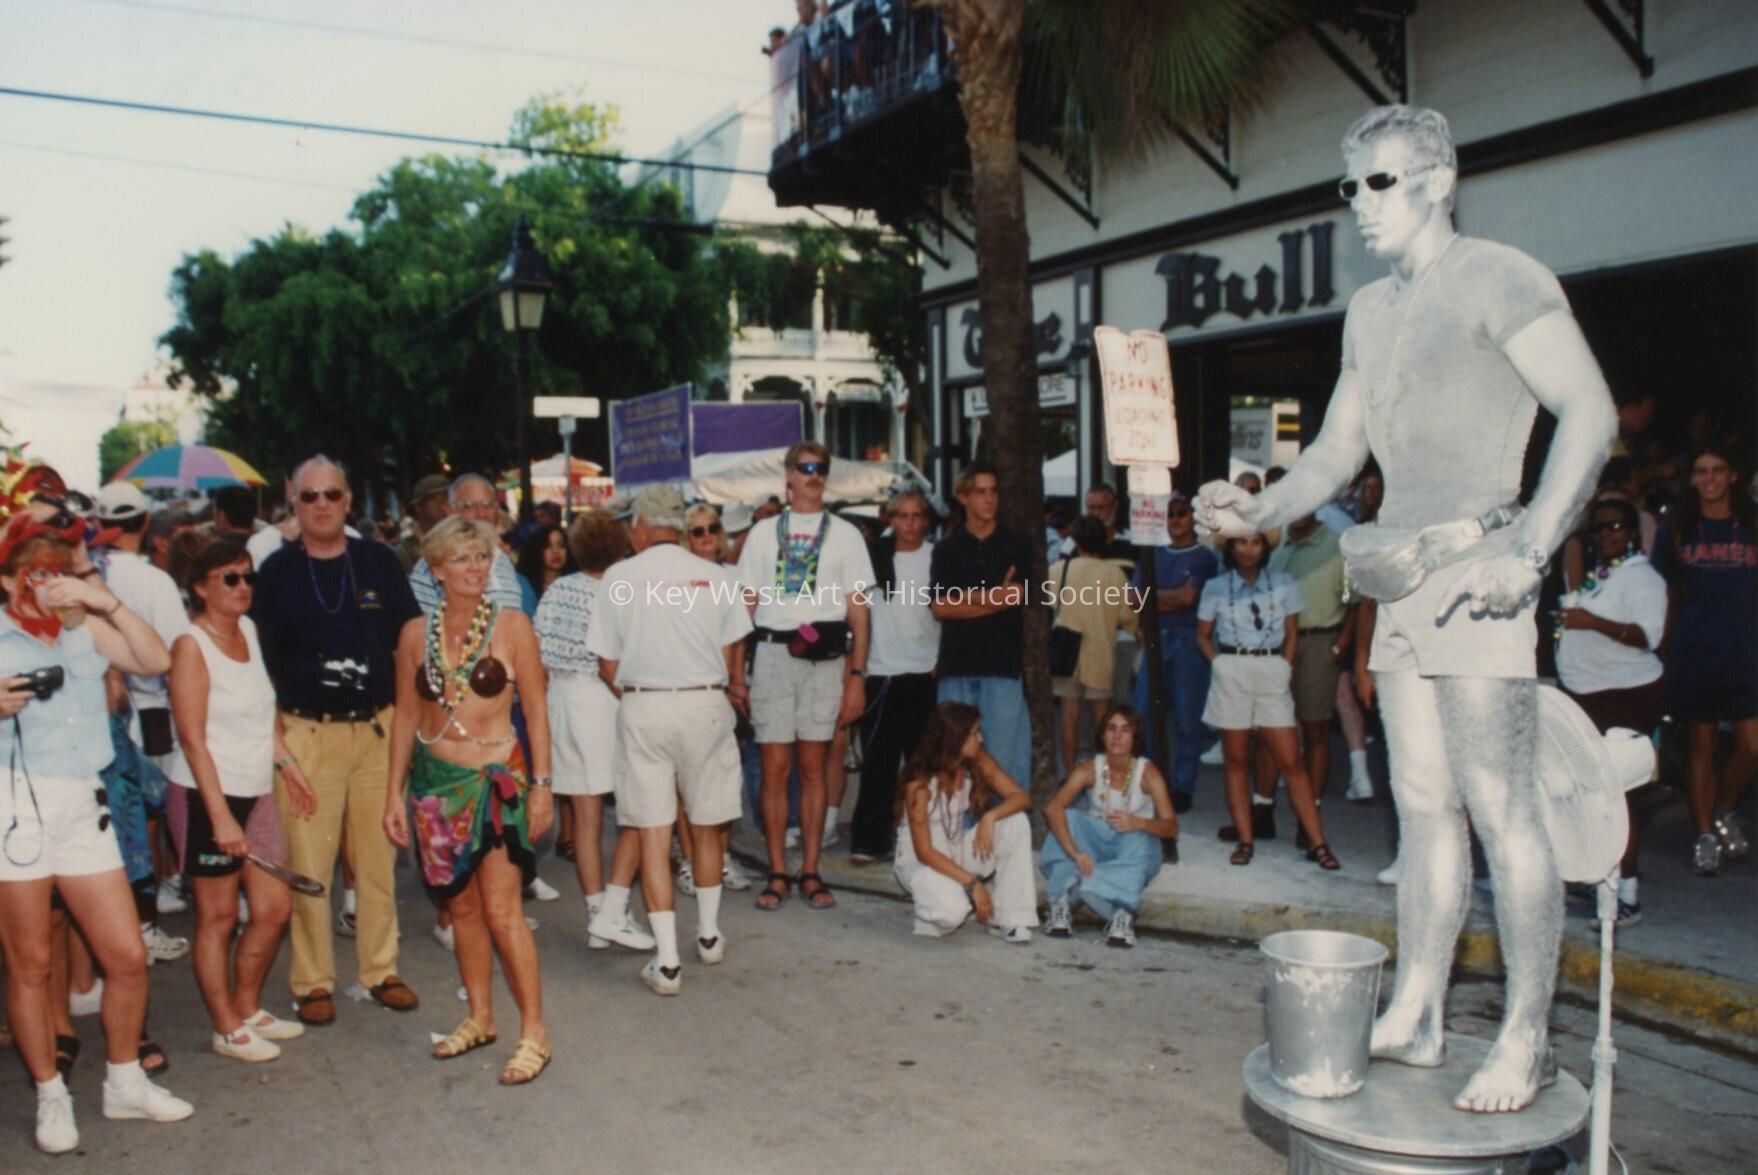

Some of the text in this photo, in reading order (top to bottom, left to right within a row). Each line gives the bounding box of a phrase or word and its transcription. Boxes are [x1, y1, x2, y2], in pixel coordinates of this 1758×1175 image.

[960, 220, 1335, 370] Te Bull
[1126, 339, 1149, 364] NO
[1109, 370, 1168, 400] PARKING
[1115, 406, 1166, 428] LOADING
